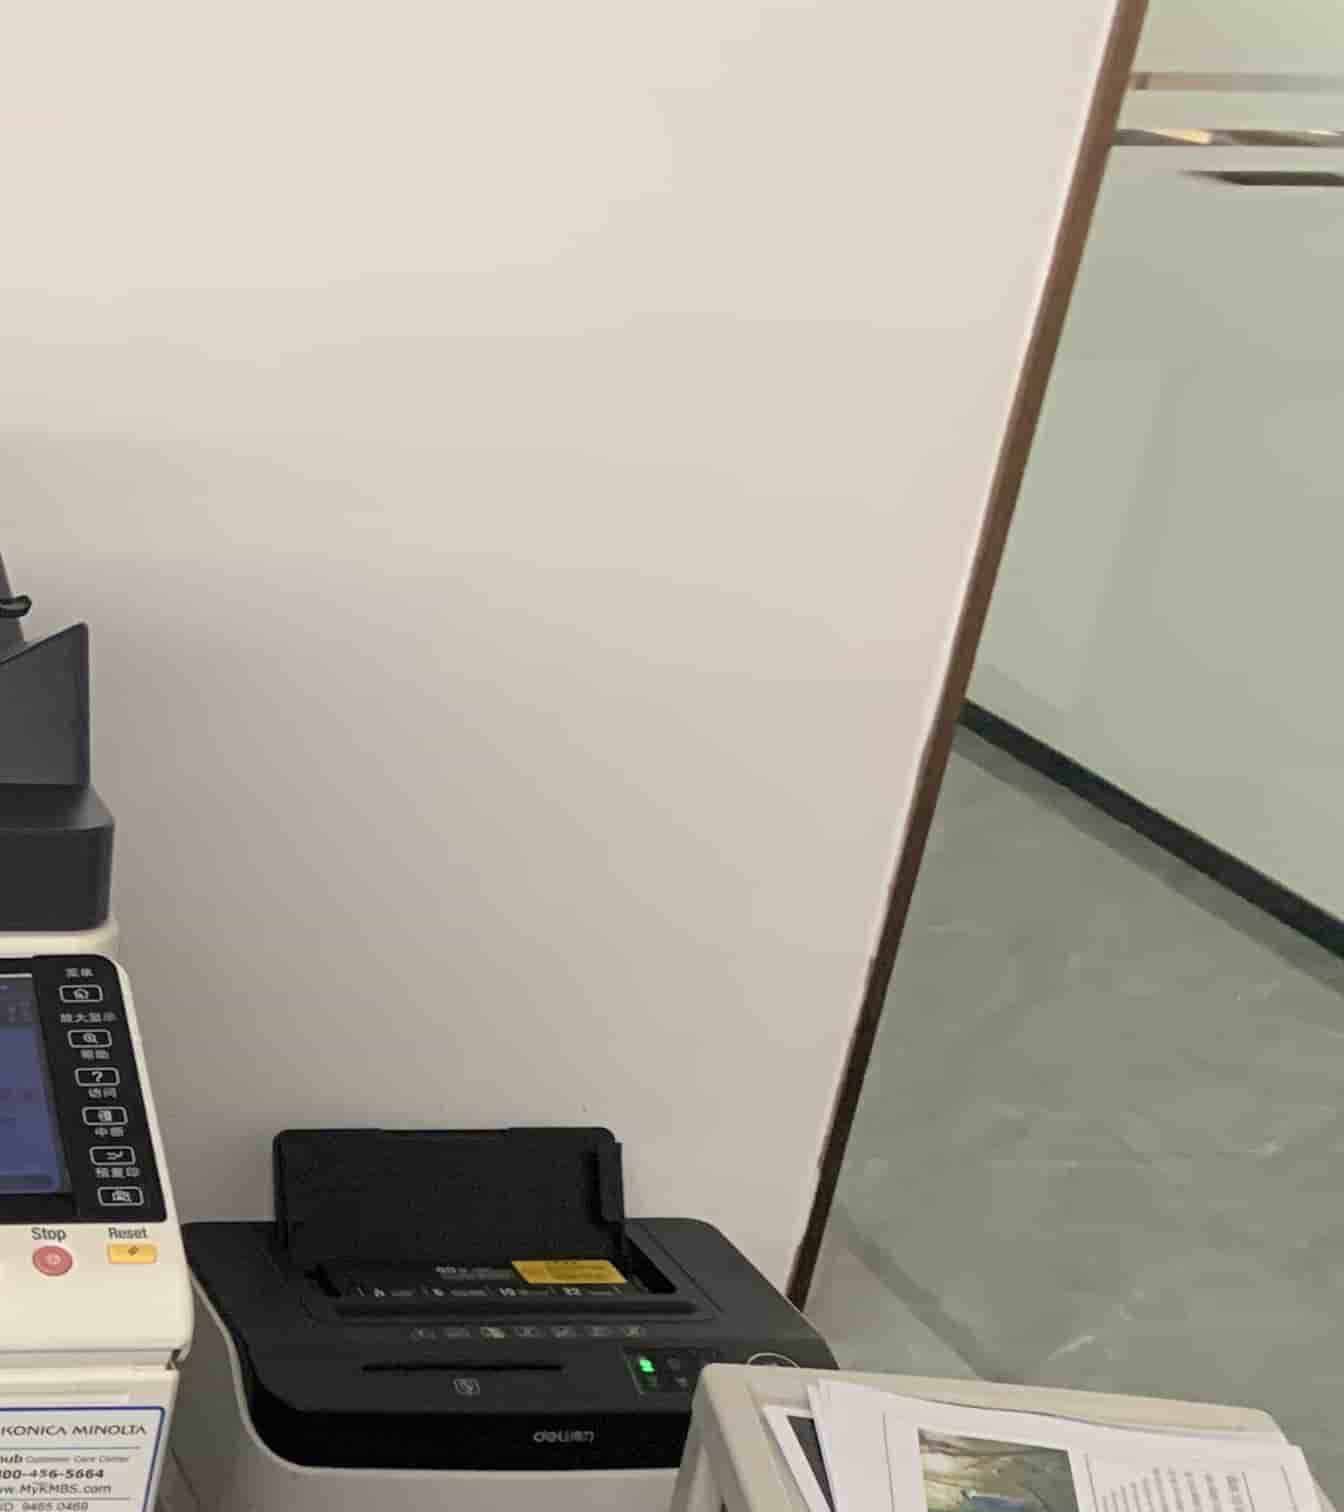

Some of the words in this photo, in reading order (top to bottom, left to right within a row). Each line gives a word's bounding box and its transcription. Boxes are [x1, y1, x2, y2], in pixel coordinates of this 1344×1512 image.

[31, 1226, 67, 1242] Stop
[108, 1227, 148, 1239] Reset
[0, 1424, 67, 1436] KONICA
[71, 1424, 147, 1436] MINOLTA
